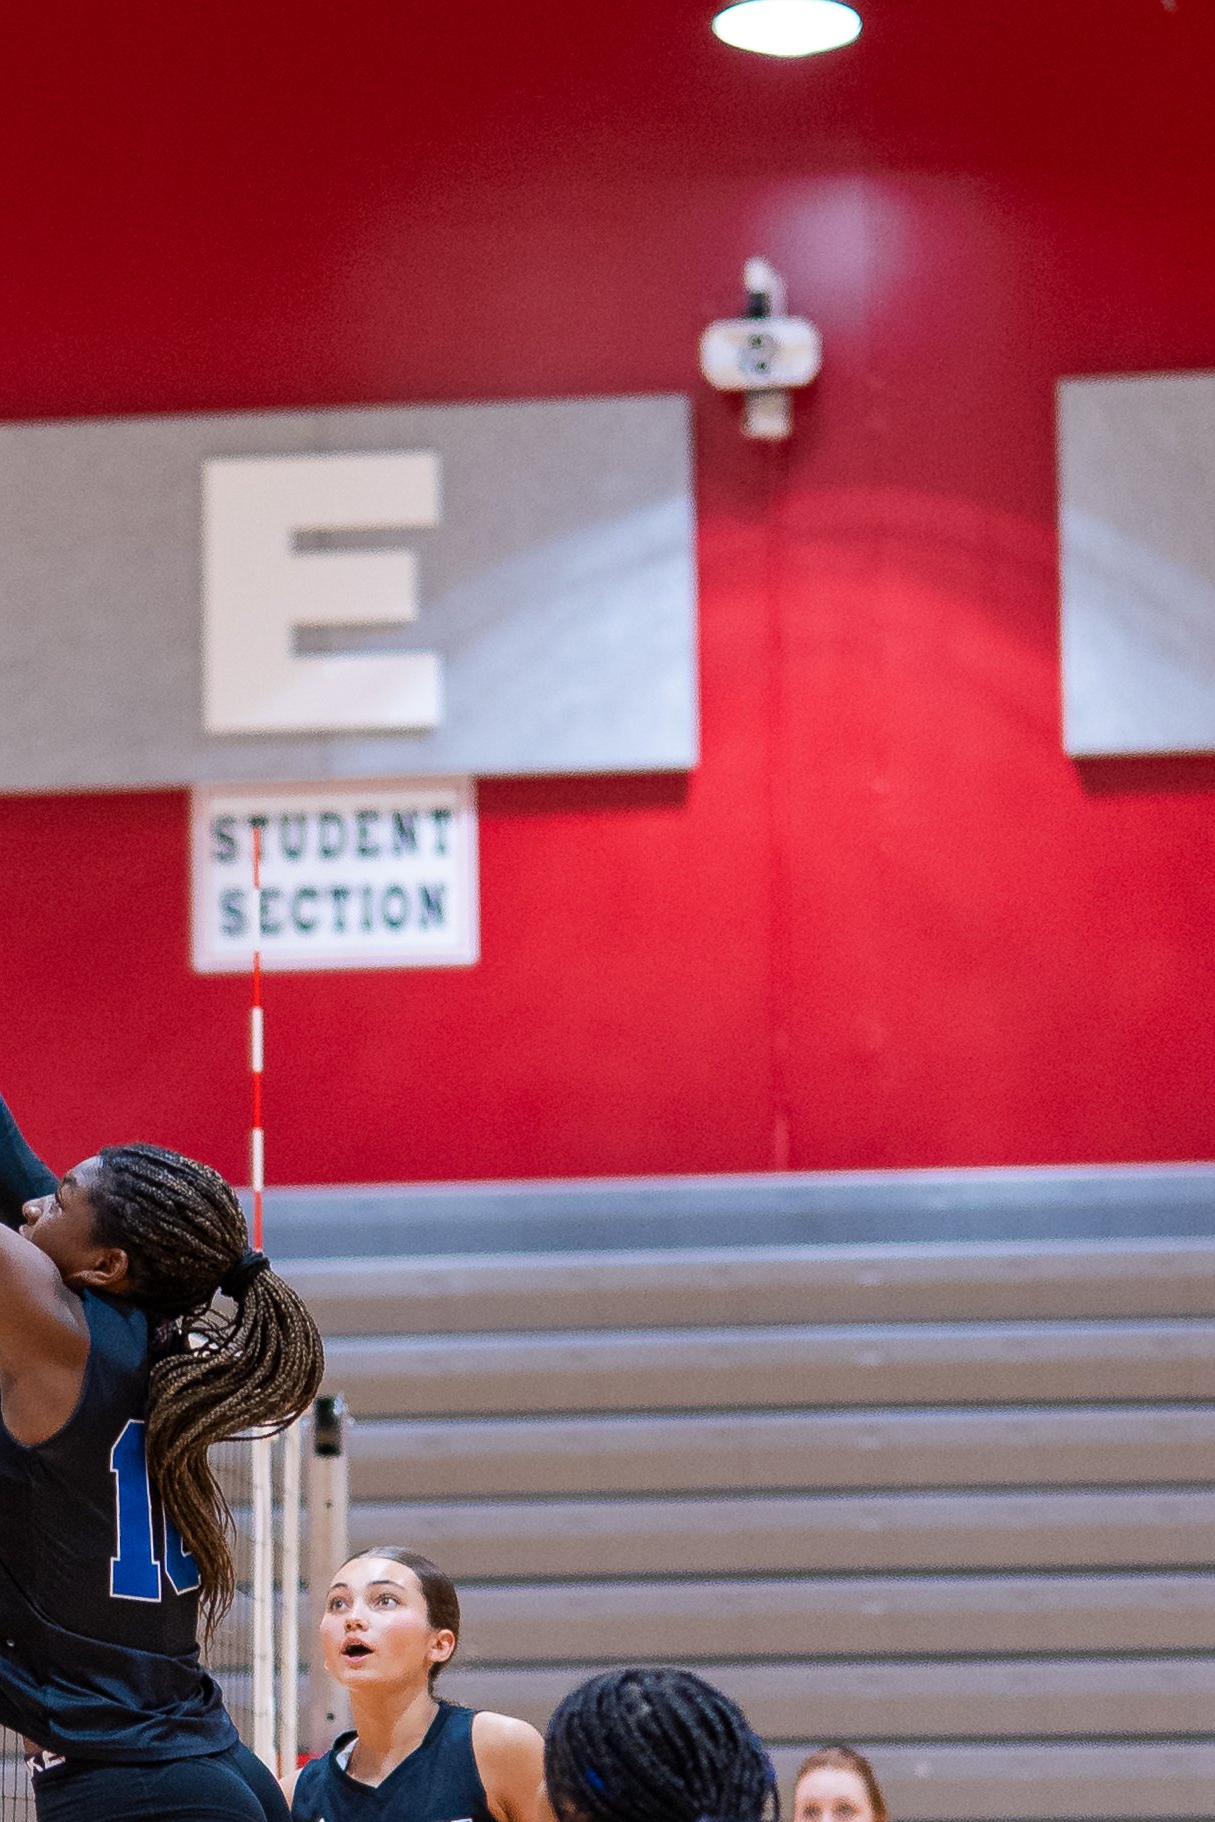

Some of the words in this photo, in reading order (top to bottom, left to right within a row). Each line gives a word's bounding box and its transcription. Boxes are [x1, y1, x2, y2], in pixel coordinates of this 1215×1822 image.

[201, 451, 443, 736] E
[211, 809, 453, 864] STUDENT
[219, 883, 447, 938] SECTION
